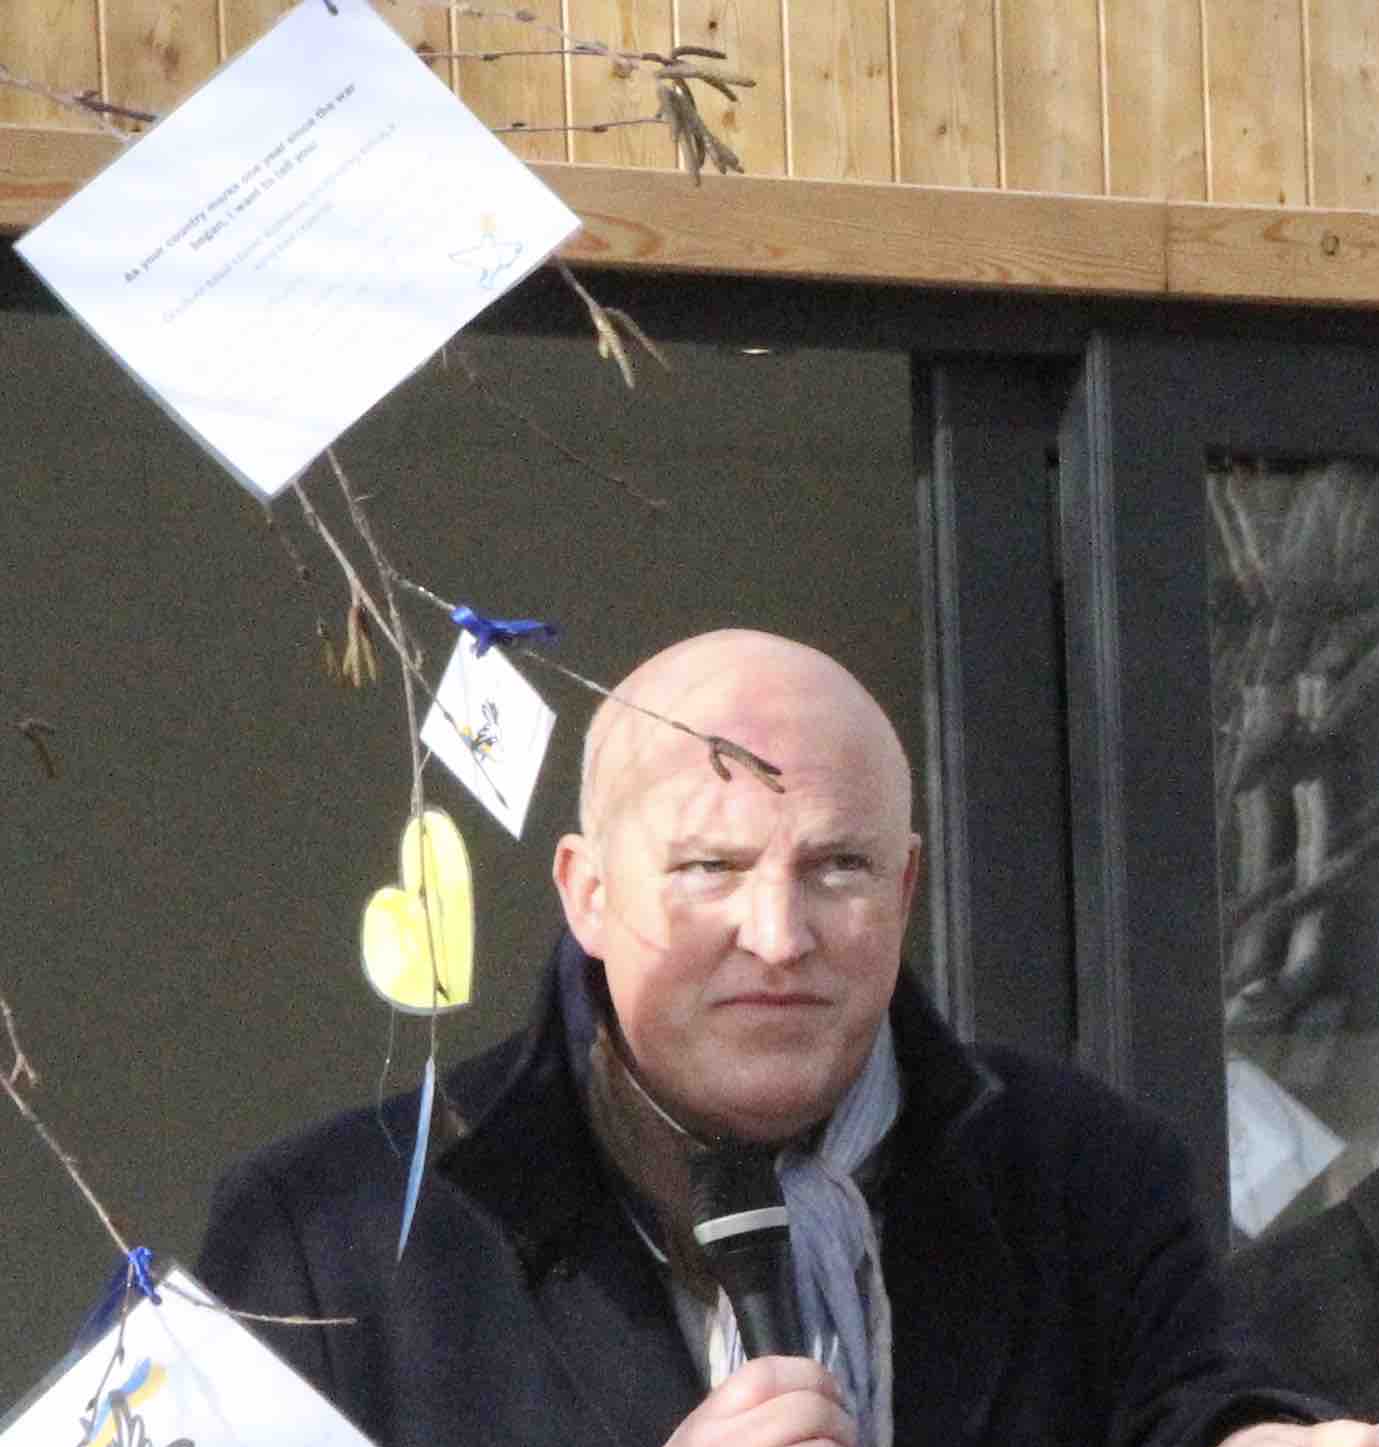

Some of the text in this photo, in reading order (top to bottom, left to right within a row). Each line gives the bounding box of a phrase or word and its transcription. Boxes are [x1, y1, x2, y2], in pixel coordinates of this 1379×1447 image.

[124, 83, 356, 282] As your country marks one year since the war
[235, 187, 261, 212] want
[259, 177, 275, 191] to
